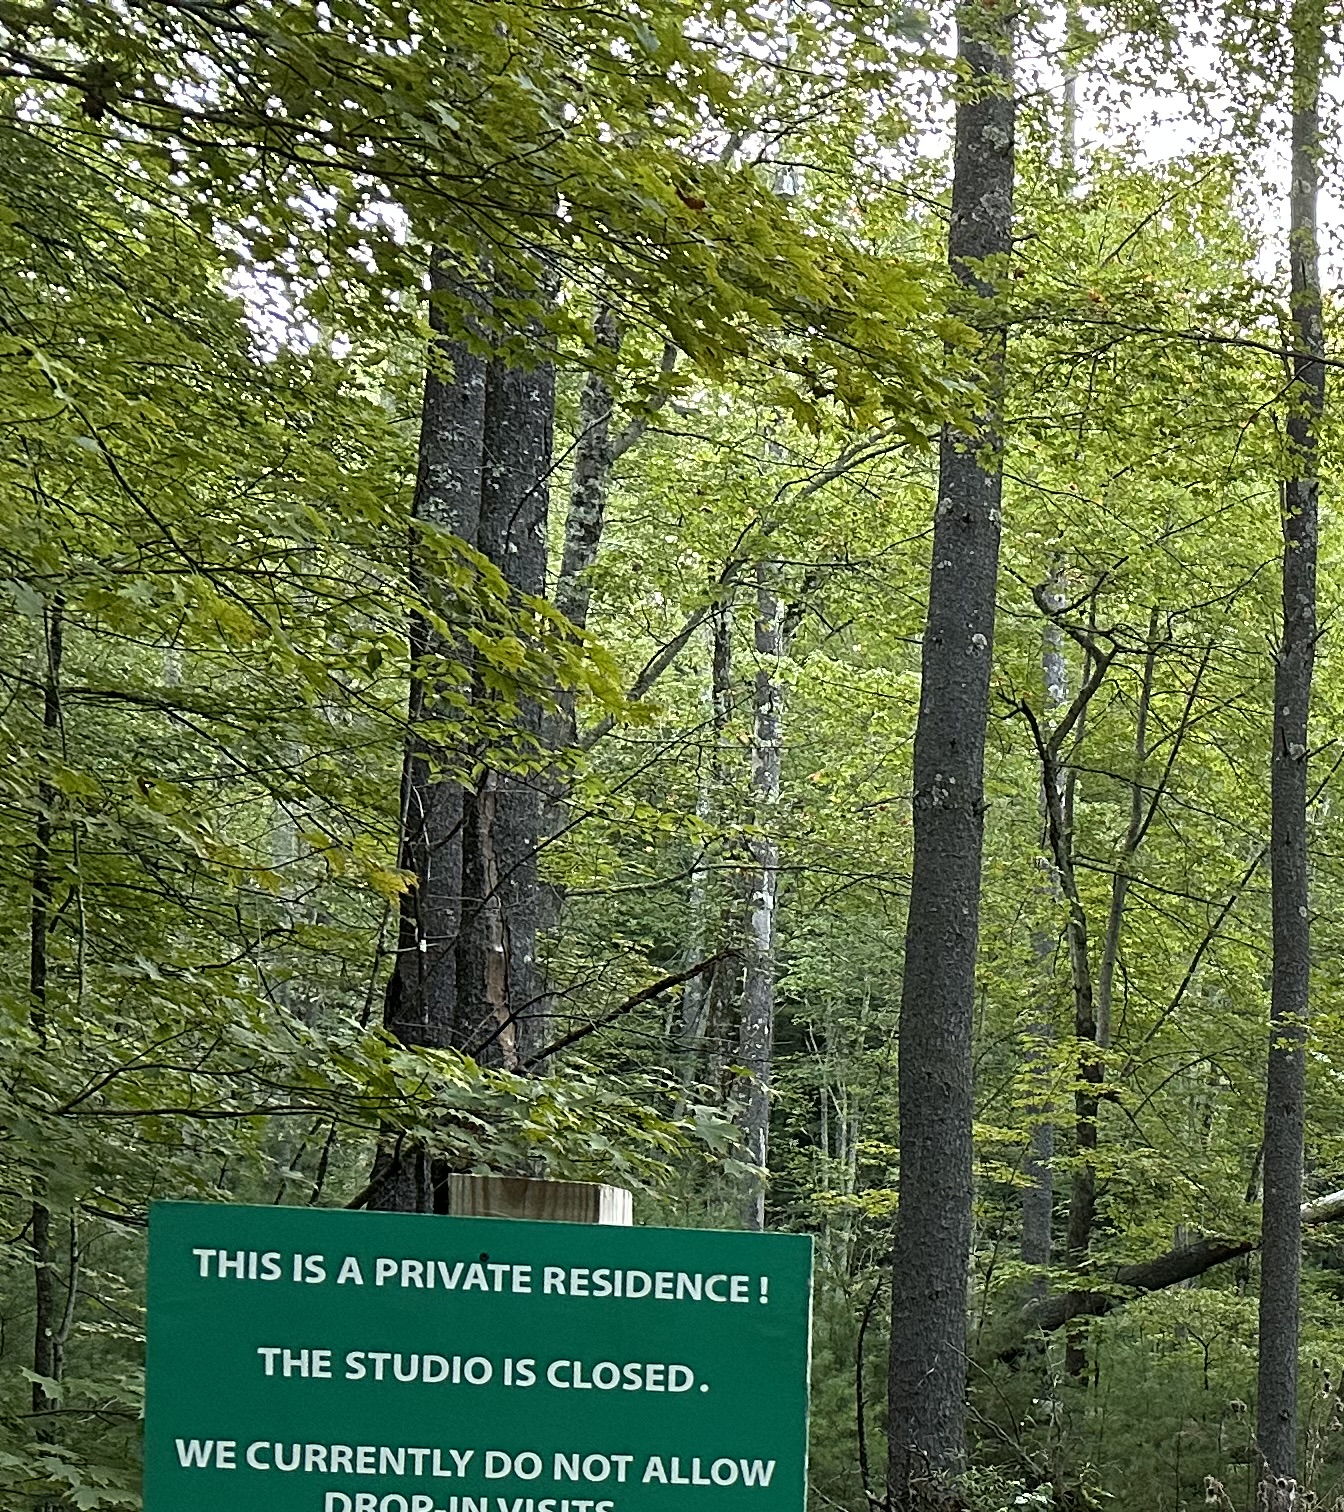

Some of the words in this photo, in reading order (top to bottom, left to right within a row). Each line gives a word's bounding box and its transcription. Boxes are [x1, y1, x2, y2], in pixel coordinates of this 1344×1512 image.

[193, 1249, 281, 1280] THIS
[293, 1253, 327, 1283] IS
[336, 1257, 364, 1285] A
[375, 1259, 532, 1294] PRIVATE
[258, 1348, 332, 1378] THE
[345, 1352, 493, 1385] STUDIO
[503, 1359, 537, 1387] IS
[546, 1361, 709, 1393] CLOSED.
[176, 1439, 237, 1469] WE
[246, 1442, 475, 1478] CURRENTLY
[484, 1451, 543, 1480] DO
[553, 1454, 634, 1483] NOT
[642, 1457, 776, 1487] ALLOW
